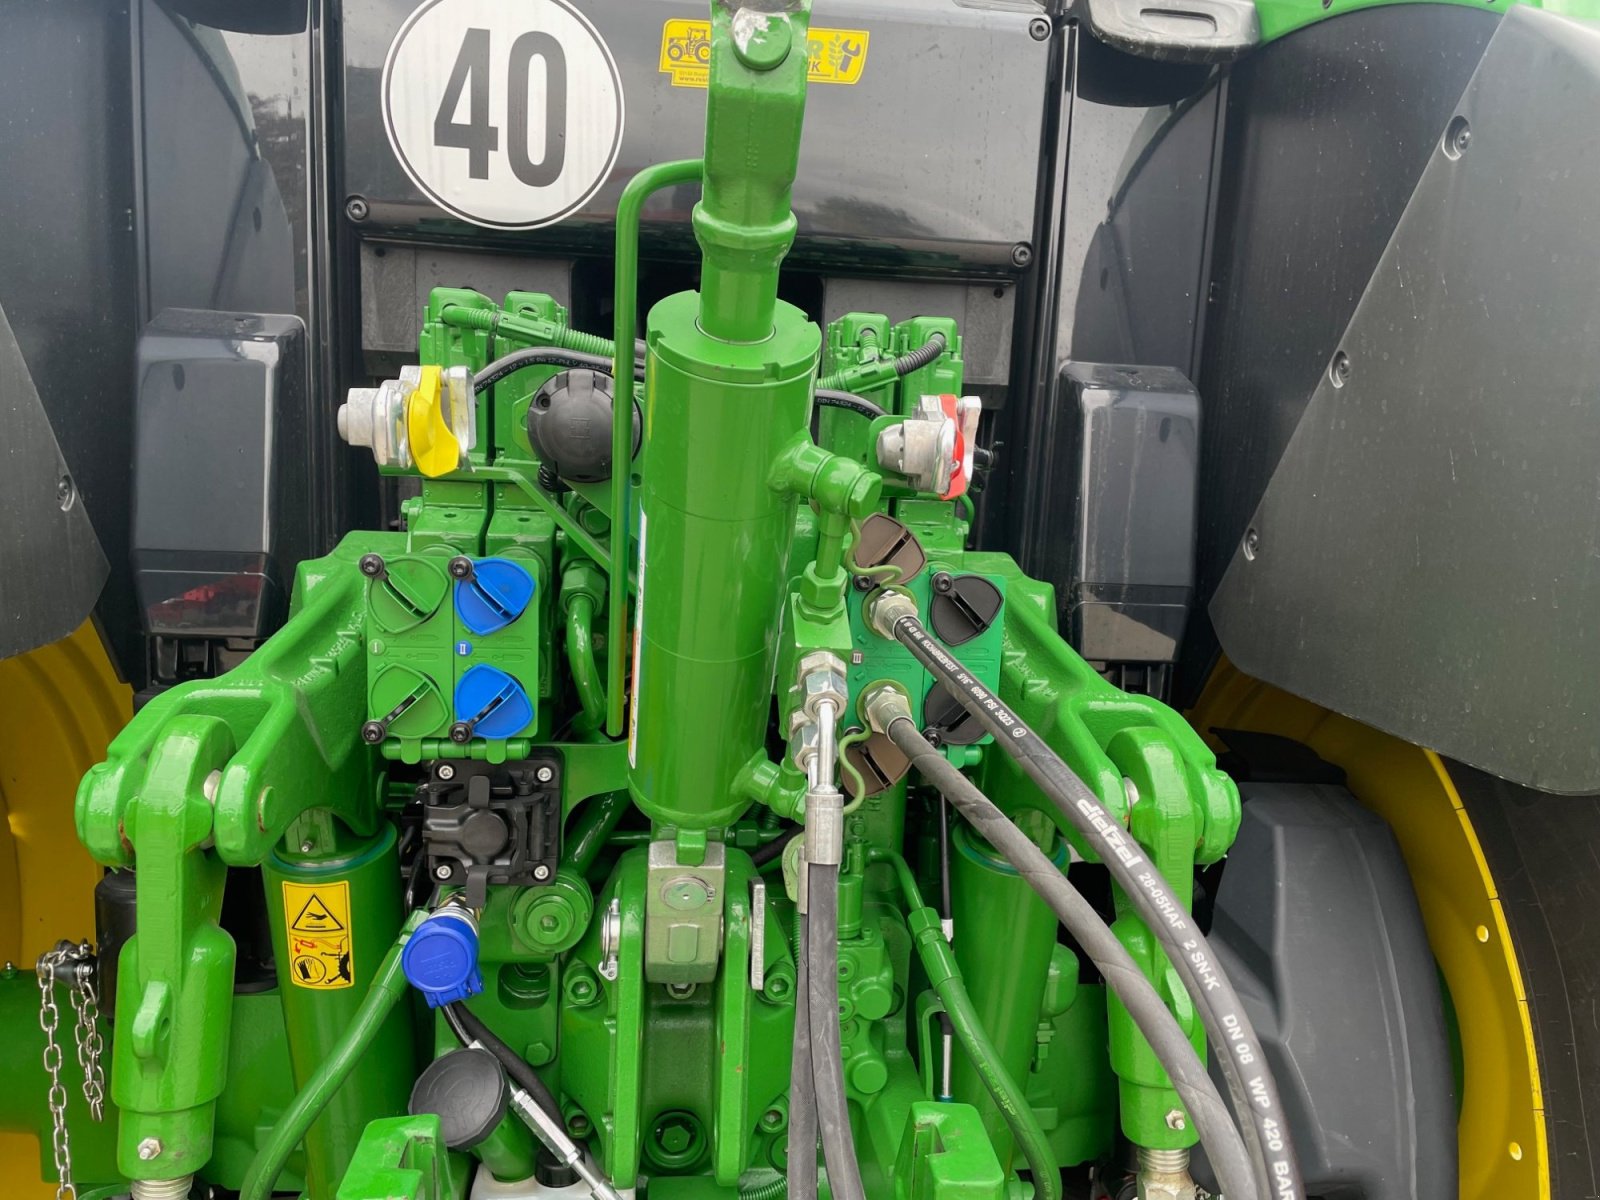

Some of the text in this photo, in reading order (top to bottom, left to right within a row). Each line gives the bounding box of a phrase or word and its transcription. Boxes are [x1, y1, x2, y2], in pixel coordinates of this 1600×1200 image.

[434, 28, 567, 187] 40
[984, 699, 999, 710] PSI
[1077, 798, 1143, 868] dietzel
[1138, 872, 1186, 931] 28-05HAF
[1184, 939, 1197, 950] 2
[1191, 951, 1220, 991] SN-K
[1222, 1013, 1244, 1040] DN
[1235, 1043, 1255, 1065] 08
[1248, 1076, 1270, 1109] WP
[1263, 1117, 1284, 1152] 420
